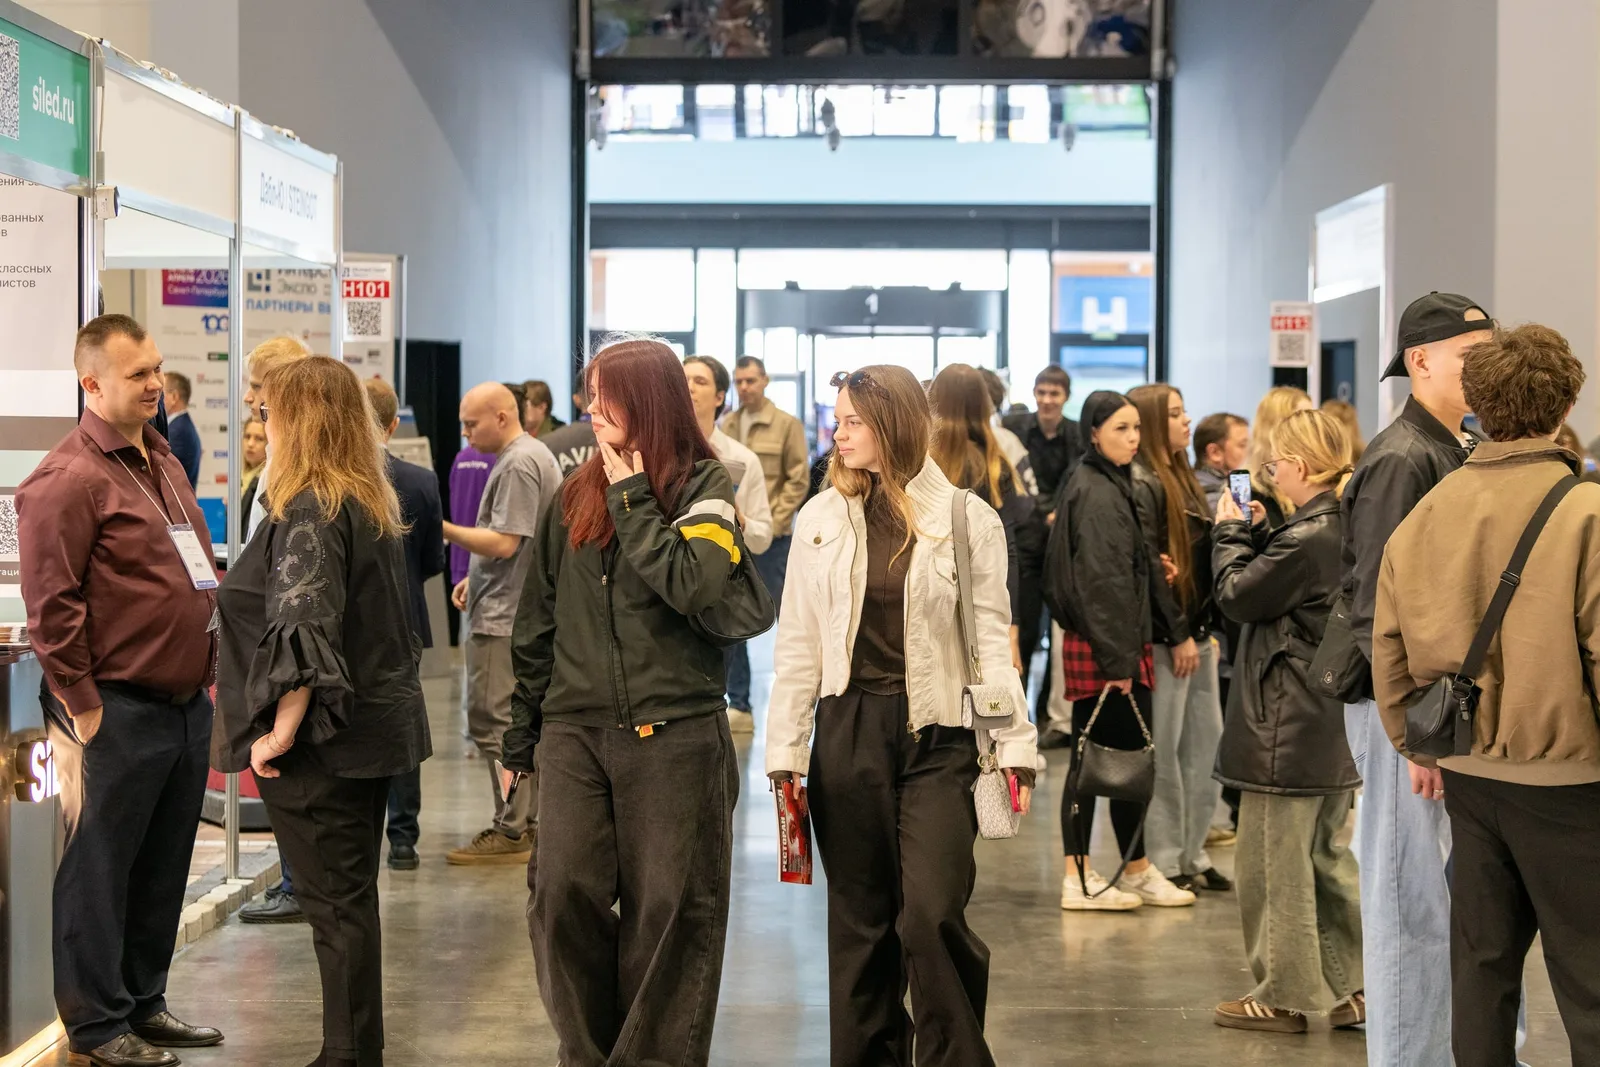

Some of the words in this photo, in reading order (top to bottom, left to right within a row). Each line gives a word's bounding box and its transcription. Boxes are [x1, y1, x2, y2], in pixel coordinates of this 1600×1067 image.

[32, 76, 74, 124] siled.ru
[0, 214, 44, 223] ванных
[0, 279, 36, 288] истов
[343, 281, 386, 297] H101
[246, 299, 313, 313] ПАРТНЕРЫ
